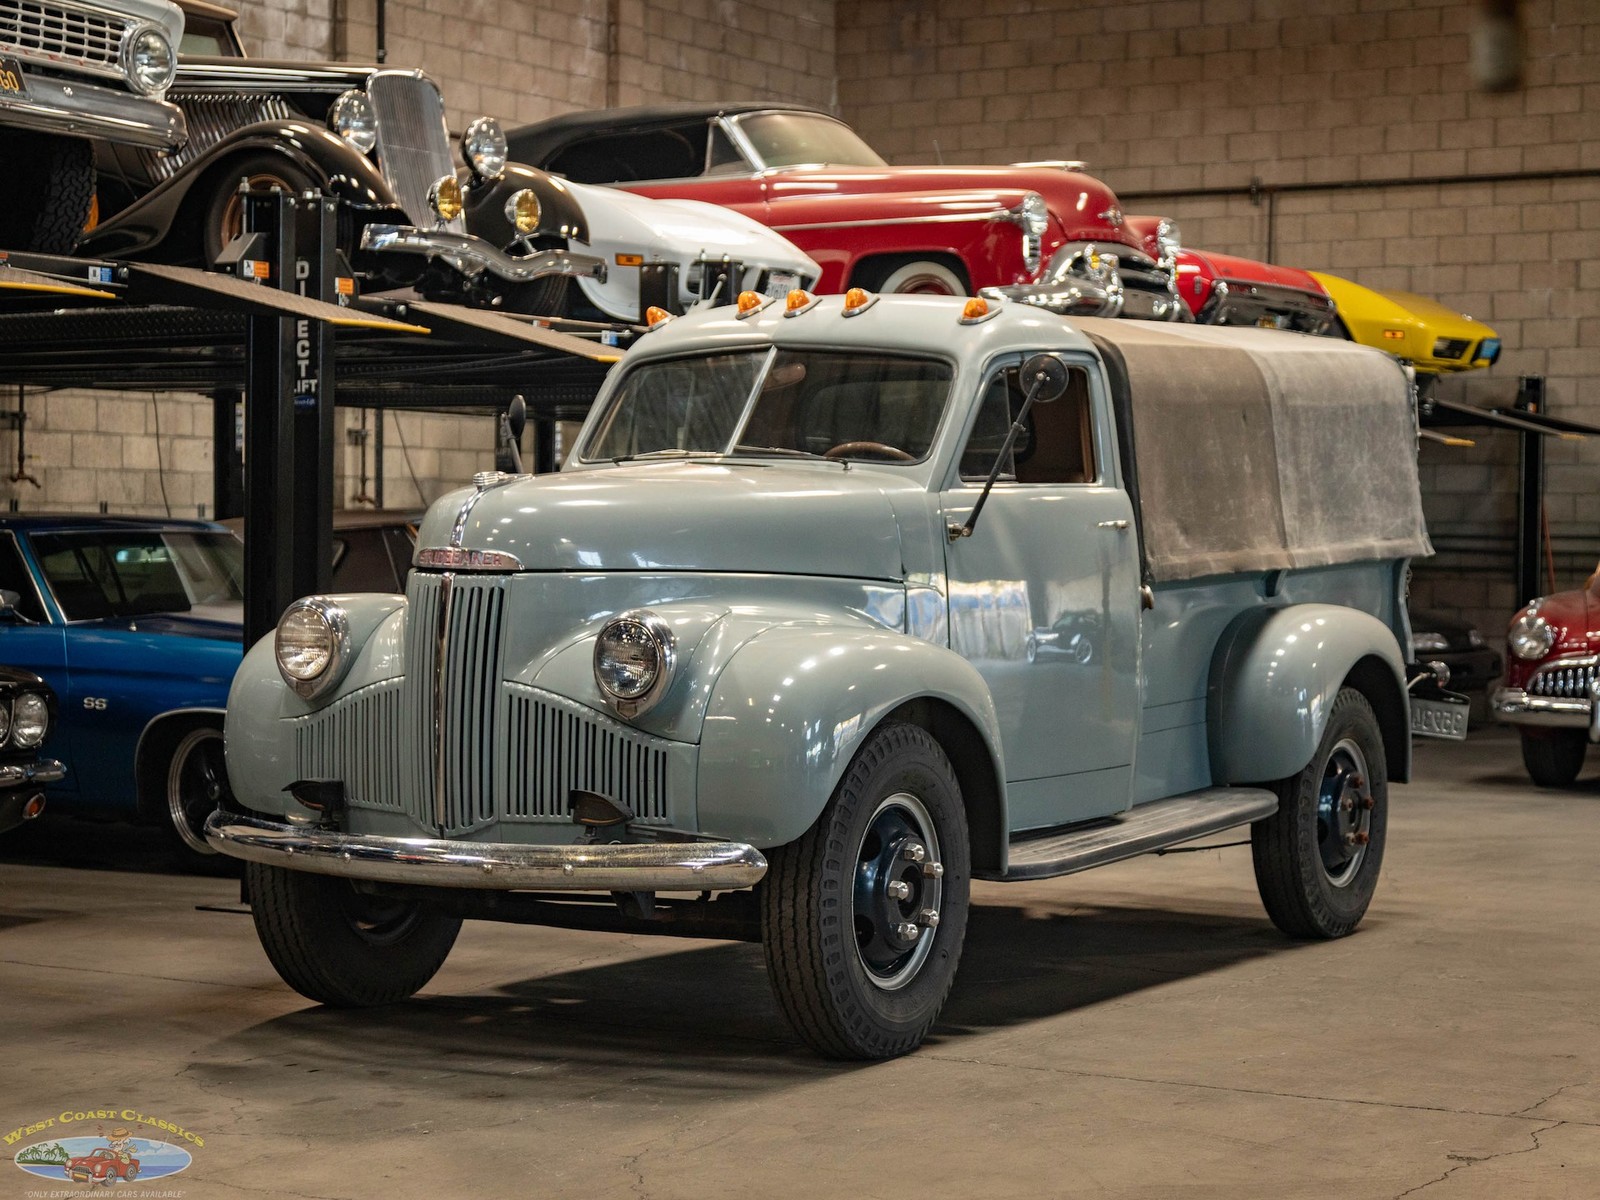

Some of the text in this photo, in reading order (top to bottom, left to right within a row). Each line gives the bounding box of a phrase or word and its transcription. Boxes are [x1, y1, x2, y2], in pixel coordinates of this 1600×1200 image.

[295, 260, 310, 378] DIECT
[293, 379, 318, 393] IFT
[83, 696, 107, 710] SS
